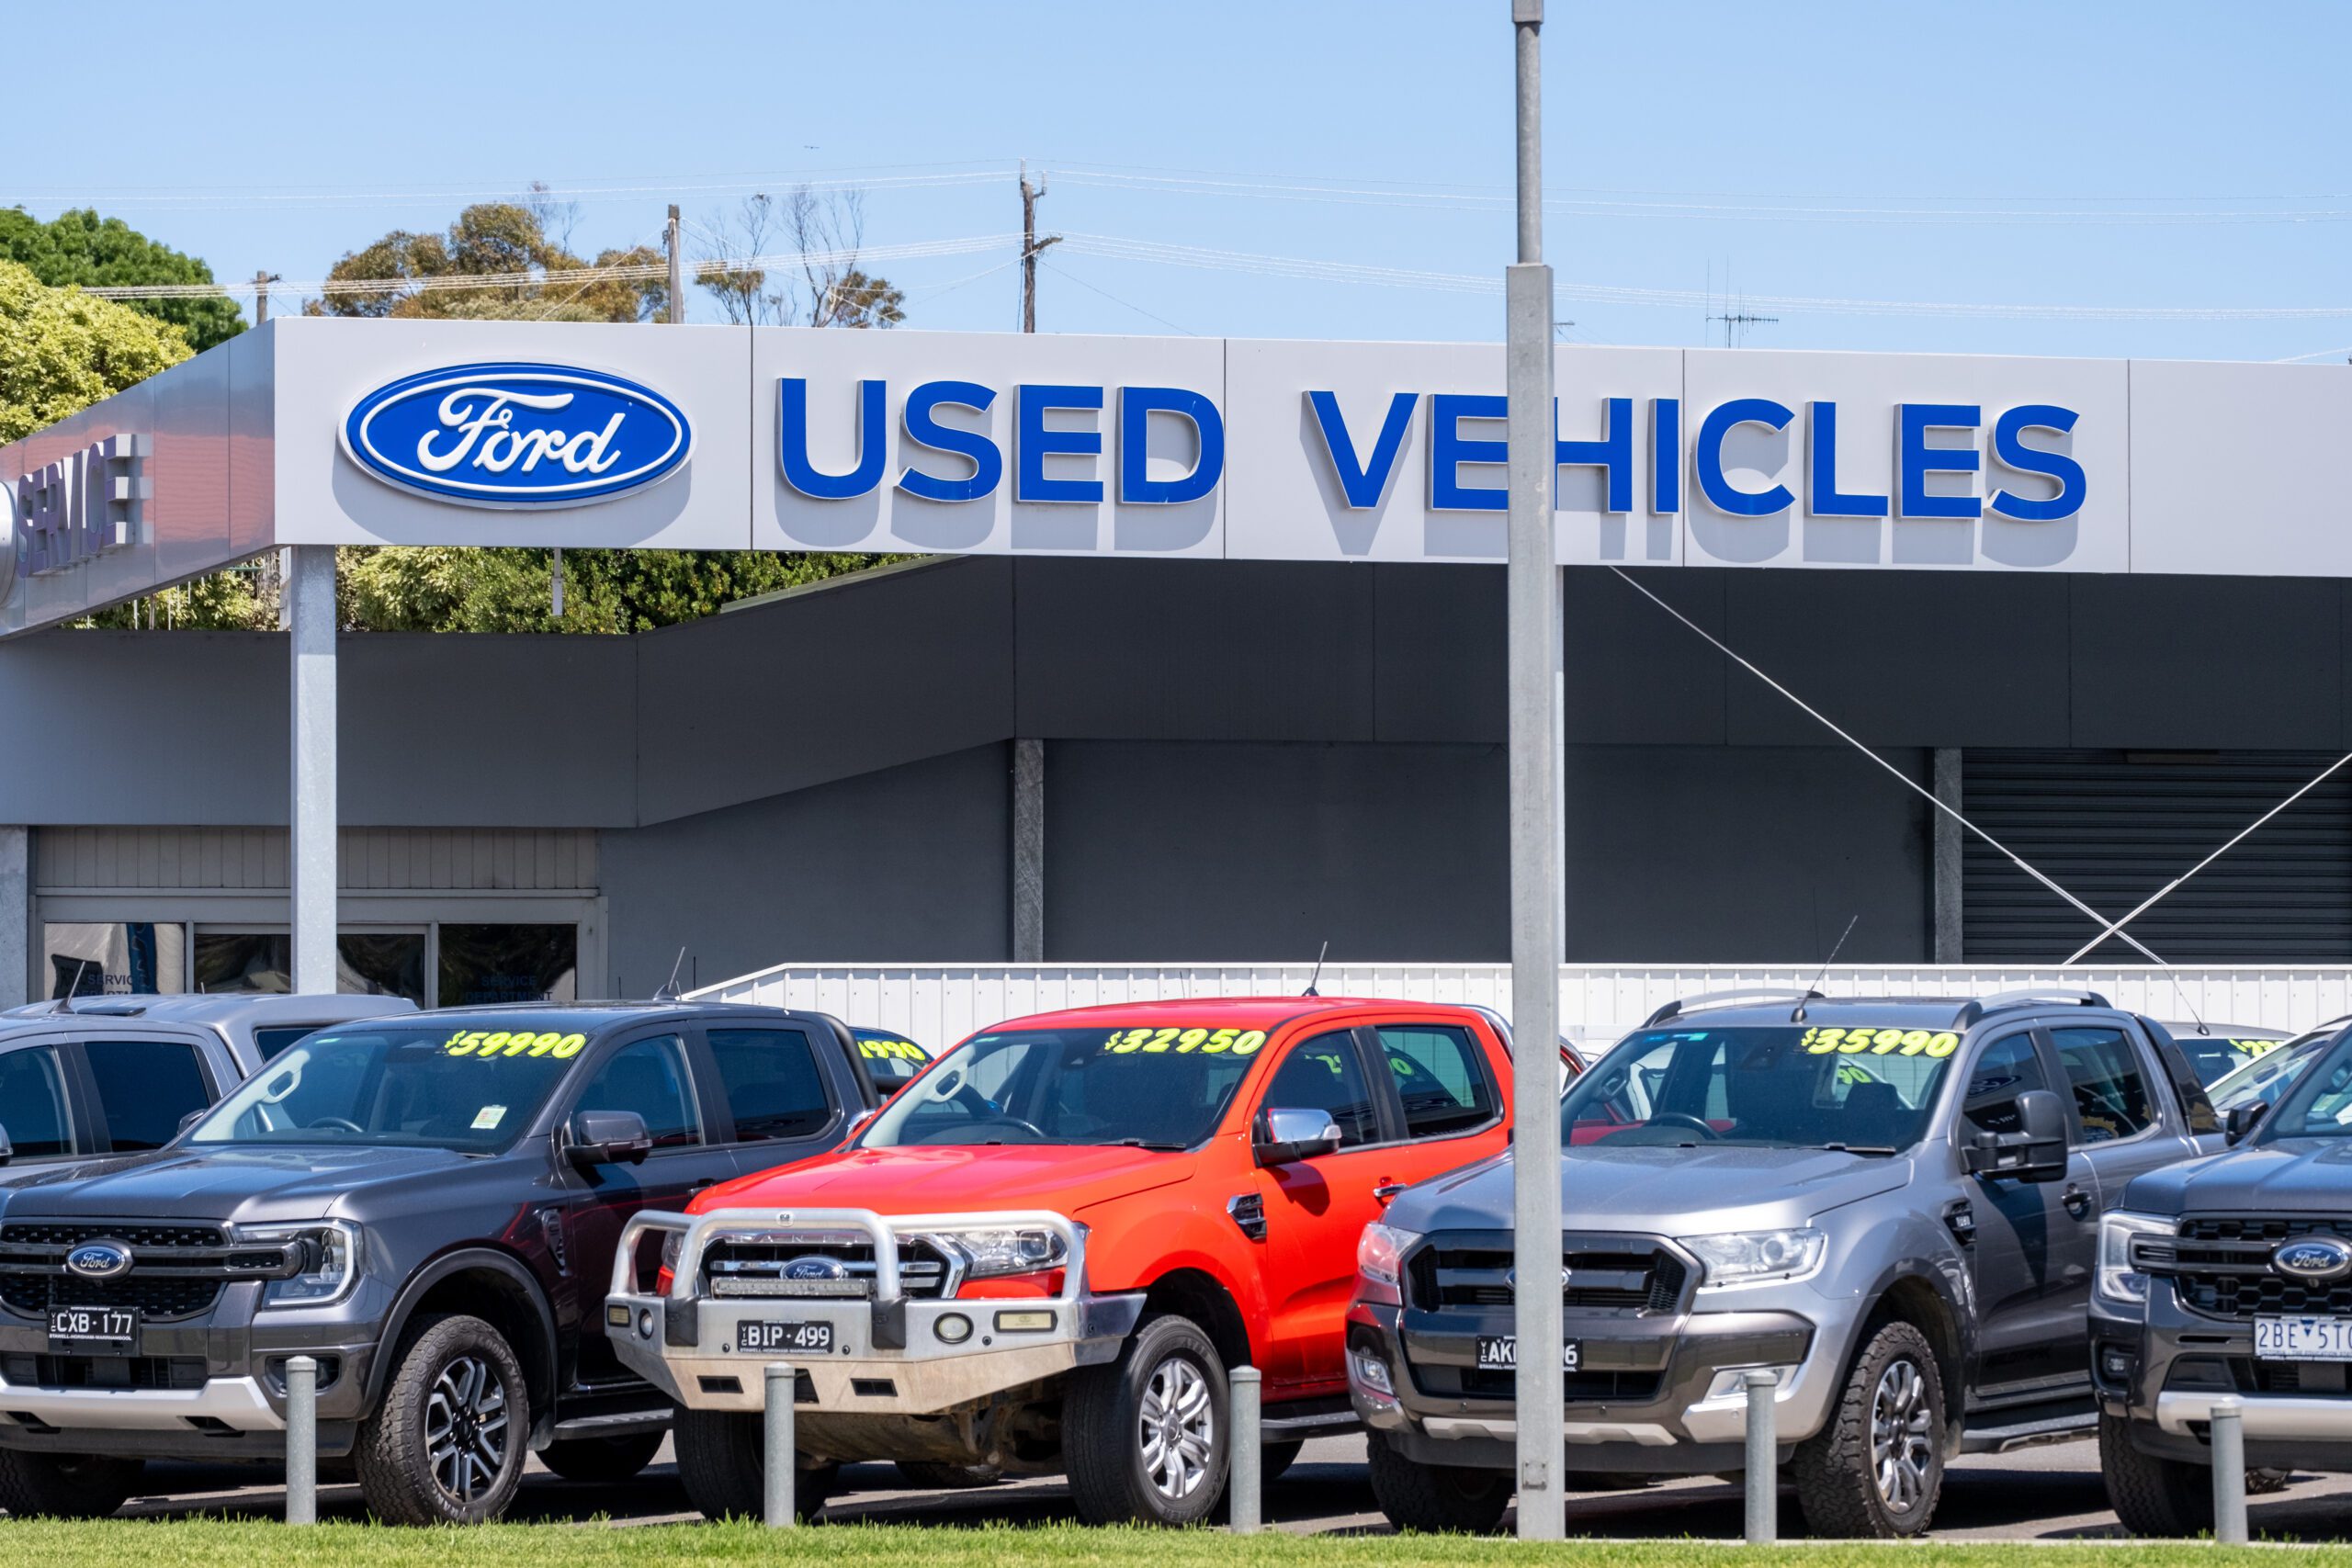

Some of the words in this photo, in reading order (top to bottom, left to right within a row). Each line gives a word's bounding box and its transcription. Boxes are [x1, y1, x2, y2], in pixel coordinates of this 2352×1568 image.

[417, 389, 626, 473] Ford
[777, 377, 1225, 504] USED
[1302, 390, 2086, 522] VEHICLES
[17, 434, 132, 579] SERVICE
[444, 1030, 586, 1059] $59990
[1104, 1028, 1266, 1055] $32950
[1801, 1026, 1959, 1057] $35990
[80, 1251, 110, 1269] Ford
[2291, 1249, 2331, 1268] Ford
